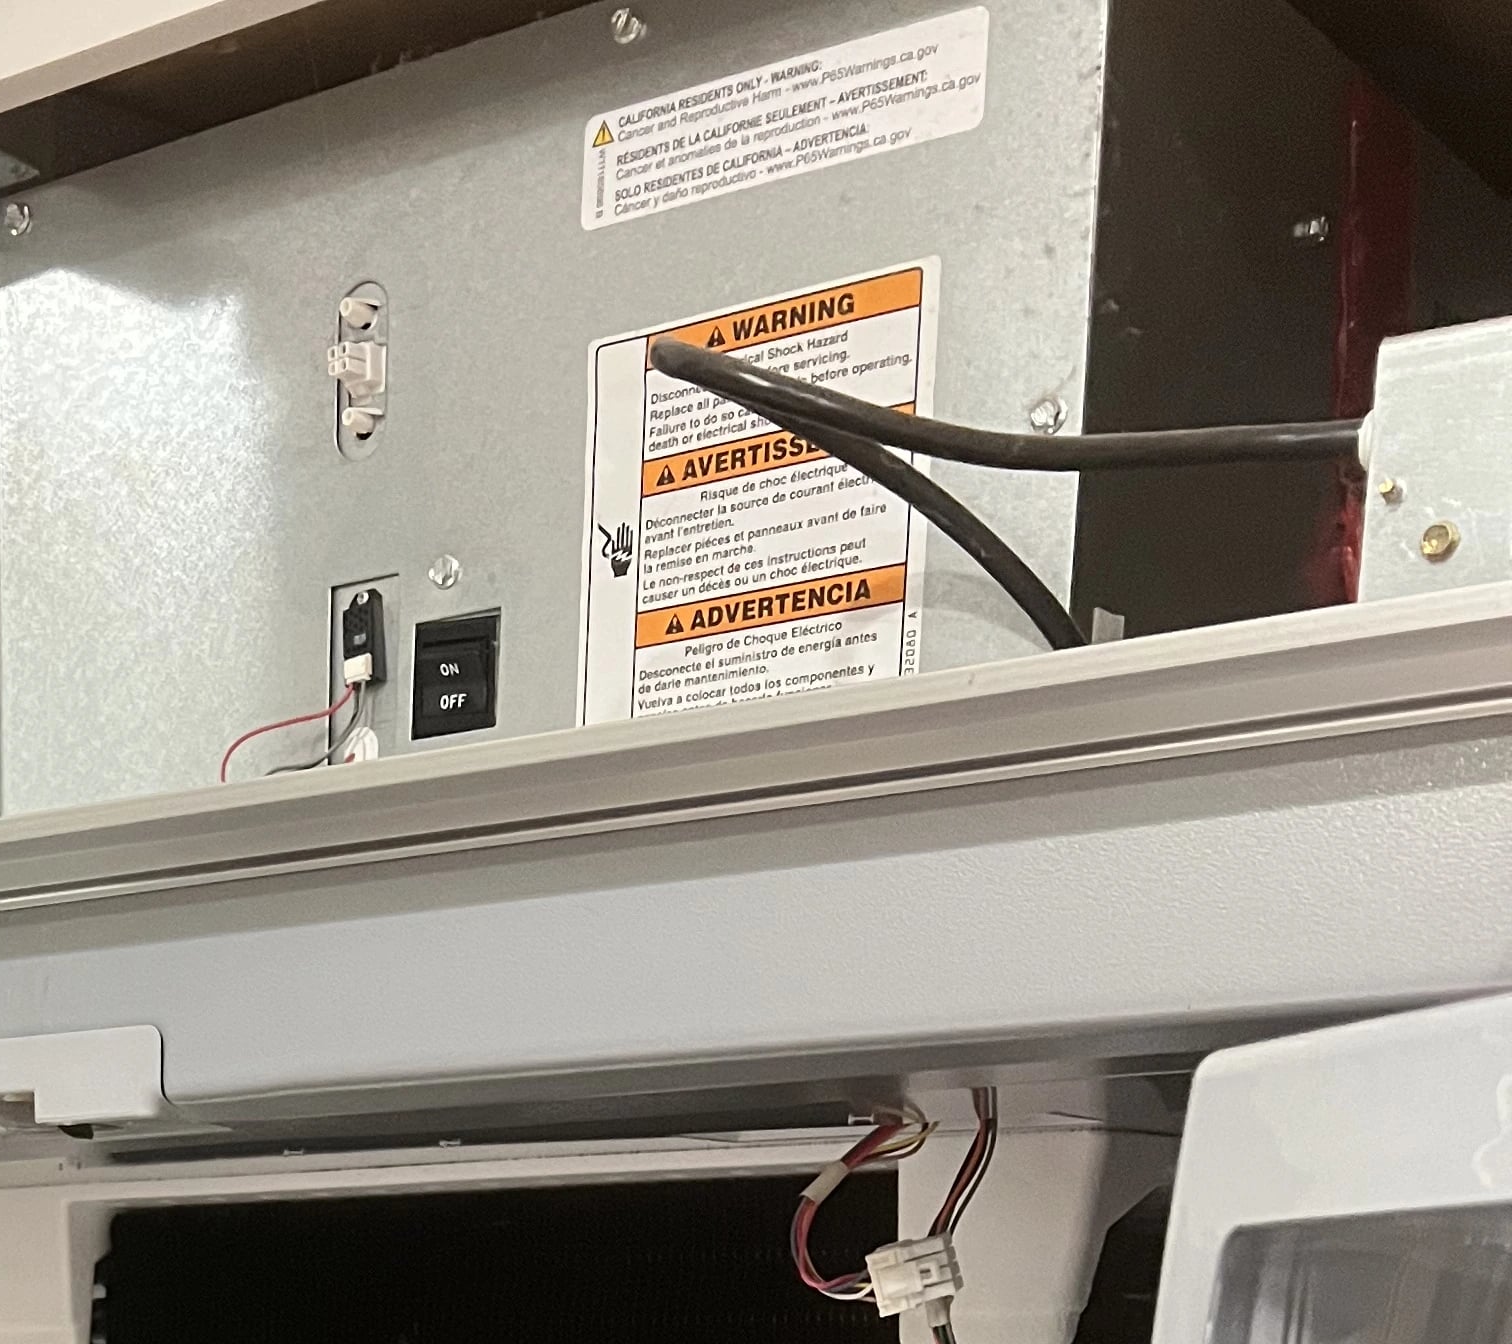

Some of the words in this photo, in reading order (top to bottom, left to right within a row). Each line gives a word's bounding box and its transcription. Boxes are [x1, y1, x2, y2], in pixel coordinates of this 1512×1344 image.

[617, 123, 655, 143] Cancer
[657, 114, 677, 132] and
[679, 96, 749, 125] Reproductive
[751, 87, 782, 104] Harm
[618, 101, 677, 128] CALIFORNIA
[677, 84, 733, 111] RESIDENTS
[735, 75, 763, 94] ONLY
[770, 59, 822, 84] WARNING:
[672, 135, 686, 151] DE
[688, 132, 701, 146] LA
[765, 95, 827, 125] SEULEMENT
[615, 161, 653, 181] Cancer
[655, 157, 666, 170] et
[723, 137, 738, 151] de
[740, 133, 750, 146] la
[752, 115, 821, 143] reproduction
[613, 197, 652, 217] Cáncer
[652, 195, 660, 209] y
[661, 186, 689, 204] daño
[690, 169, 757, 195] reproductivo
[614, 184, 641, 202] SOLO
[643, 166, 704, 194] RESIDENTES
[706, 161, 720, 177] DE
[722, 144, 783, 172] CALIFORNIA
[733, 293, 854, 341] WARNING
[767, 341, 804, 360] Shock
[806, 329, 848, 351] Hazard
[793, 350, 850, 371] servicing.
[649, 403, 694, 422] Replace
[696, 397, 710, 411] all
[809, 367, 849, 386] before
[851, 353, 913, 375] operating.
[648, 421, 686, 438] Failure
[689, 418, 701, 429] to
[703, 413, 718, 426] do
[720, 410, 735, 422] so
[648, 436, 679, 452] death
[681, 433, 694, 445] or
[696, 419, 747, 442] electrical
[645, 507, 714, 531] Déconnecter
[717, 504, 727, 516] la
[730, 496, 769, 513] source
[771, 491, 786, 504] de
[789, 480, 834, 500] courant
[700, 486, 739, 502] Risque
[741, 481, 756, 493] de
[759, 475, 787, 490] choc
[643, 542, 692, 560] Replacer
[733, 530, 744, 543] et
[747, 520, 803, 543] panneaux
[806, 511, 839, 528] avant
[841, 508, 857, 521] de
[860, 503, 887, 517] faire
[644, 527, 674, 544] avant
[641, 589, 679, 605] causer
[681, 586, 695, 597] un
[698, 578, 731, 594] décès
[734, 575, 749, 586] ou
[751, 572, 767, 583] un
[769, 566, 798, 580] choc
[800, 555, 862, 574] électrique.
[642, 579, 656, 591] Le
[658, 564, 724, 588] non-respect
[727, 562, 741, 574] de
[744, 559, 763, 571] ces
[766, 545, 837, 566] instructions
[839, 537, 866, 555] peut
[643, 563, 653, 574] la
[655, 556, 693, 572] remise
[695, 553, 709, 564] en
[690, 579, 871, 631] ADVERTENCIA
[638, 661, 702, 681] Desconecte
[704, 657, 715, 670] el
[717, 649, 778, 668] suministro
[780, 645, 795, 657] de
[798, 635, 842, 654] energía
[844, 632, 877, 646] antes
[684, 642, 724, 657] Peligro
[726, 637, 740, 650] de
[743, 631, 788, 646] Choque
[791, 621, 843, 638] Eléctrico
[440, 663, 460, 677] ON
[637, 683, 651, 695] de
[654, 678, 681, 692] darle
[637, 696, 673, 711] Vuelva
[676, 695, 683, 705] a
[685, 688, 726, 703] colocar
[729, 682, 761, 695] todos
[764, 678, 782, 689] los
[784, 665, 864, 686] componentes
[867, 664, 875, 676] y
[440, 693, 467, 710] OFF
